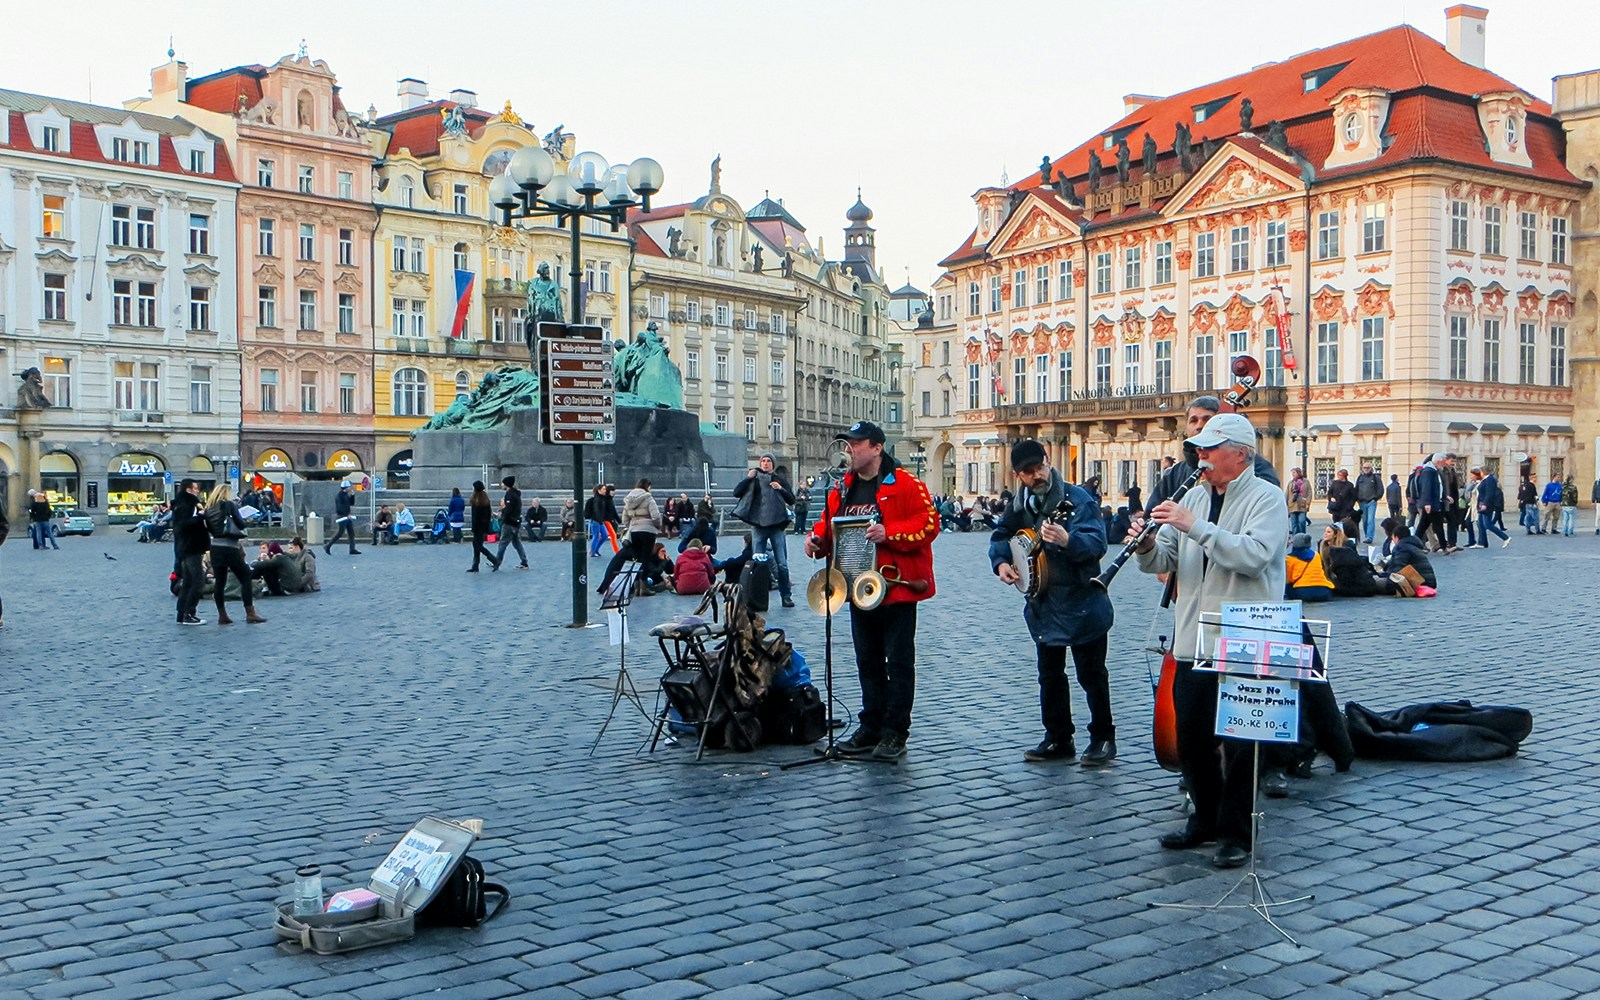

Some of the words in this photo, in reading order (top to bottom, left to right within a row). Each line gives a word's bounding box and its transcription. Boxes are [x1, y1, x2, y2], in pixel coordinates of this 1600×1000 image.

[1115, 384, 1157, 397] GALERIE
[595, 431, 602, 440] A
[1262, 605, 1292, 613] Problem
[1237, 683, 1262, 694] Jazz
[1266, 686, 1281, 695] No
[1220, 691, 1296, 706] Problem-Praha
[1251, 709, 1264, 718] CD
[1227, 716, 1261, 729] 250,-Kč
[1264, 721, 1289, 730] 10,-€
